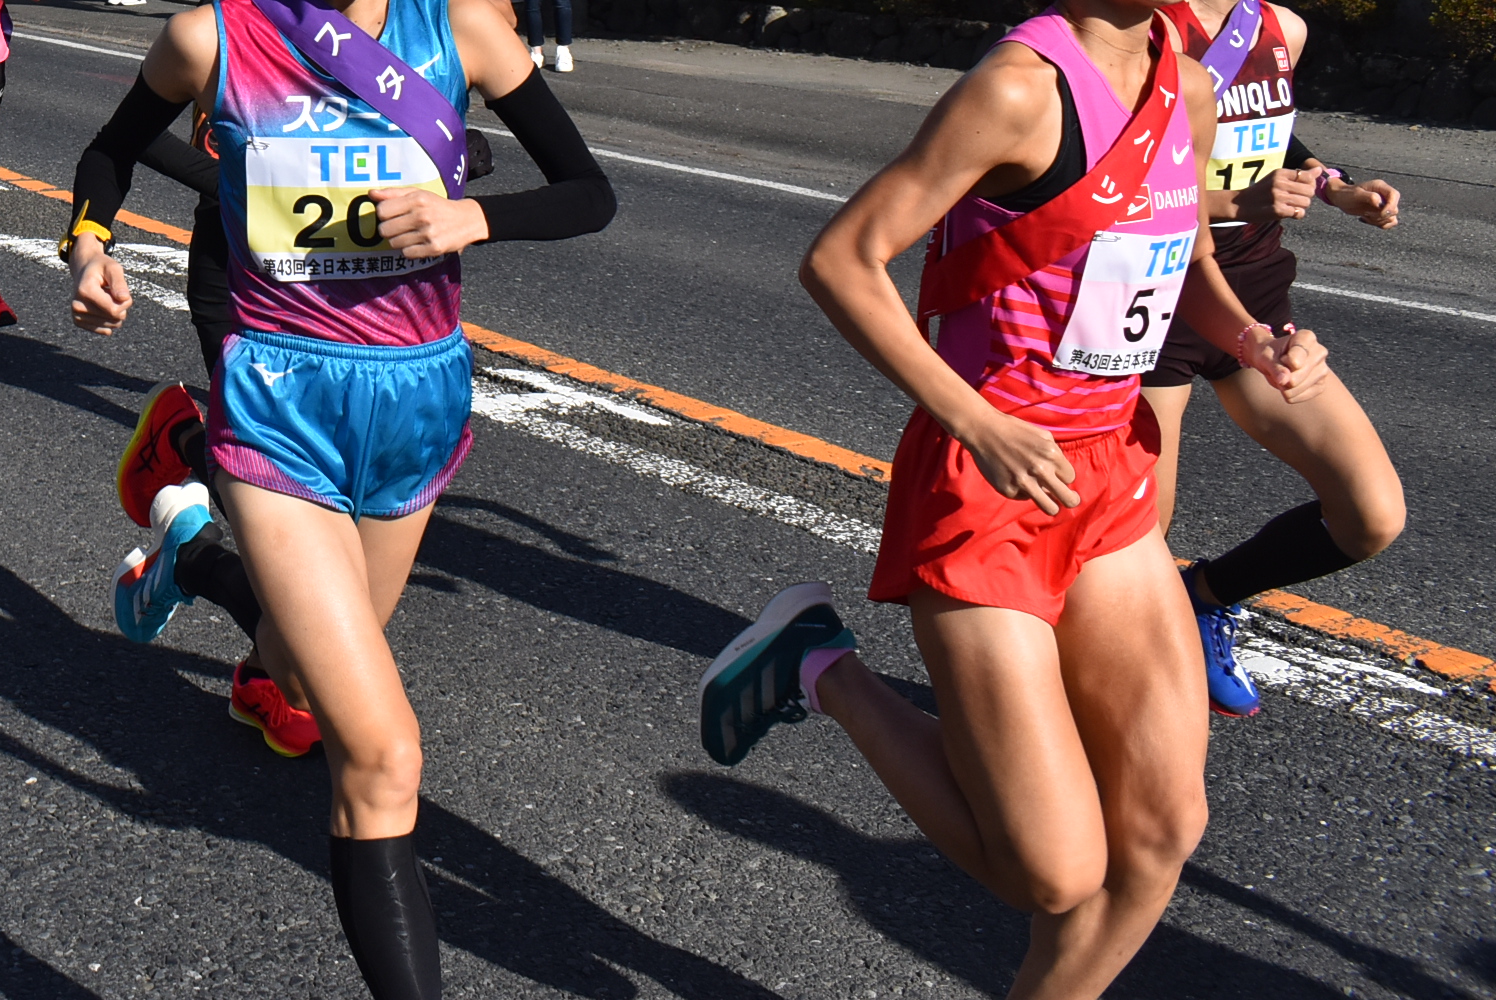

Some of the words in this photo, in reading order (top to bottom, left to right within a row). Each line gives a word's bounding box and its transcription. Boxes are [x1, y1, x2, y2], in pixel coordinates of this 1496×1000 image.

[314, 21, 466, 187] スターツ
[1233, 122, 1280, 153] TEL
[310, 145, 402, 182] TEL
[1216, 159, 1265, 191] 17
[292, 194, 384, 249] 20
[262, 254, 449, 278] 第43回全日本実業団女子
[1145, 236, 1191, 278] TEL
[1123, 287, 1172, 344] 5-
